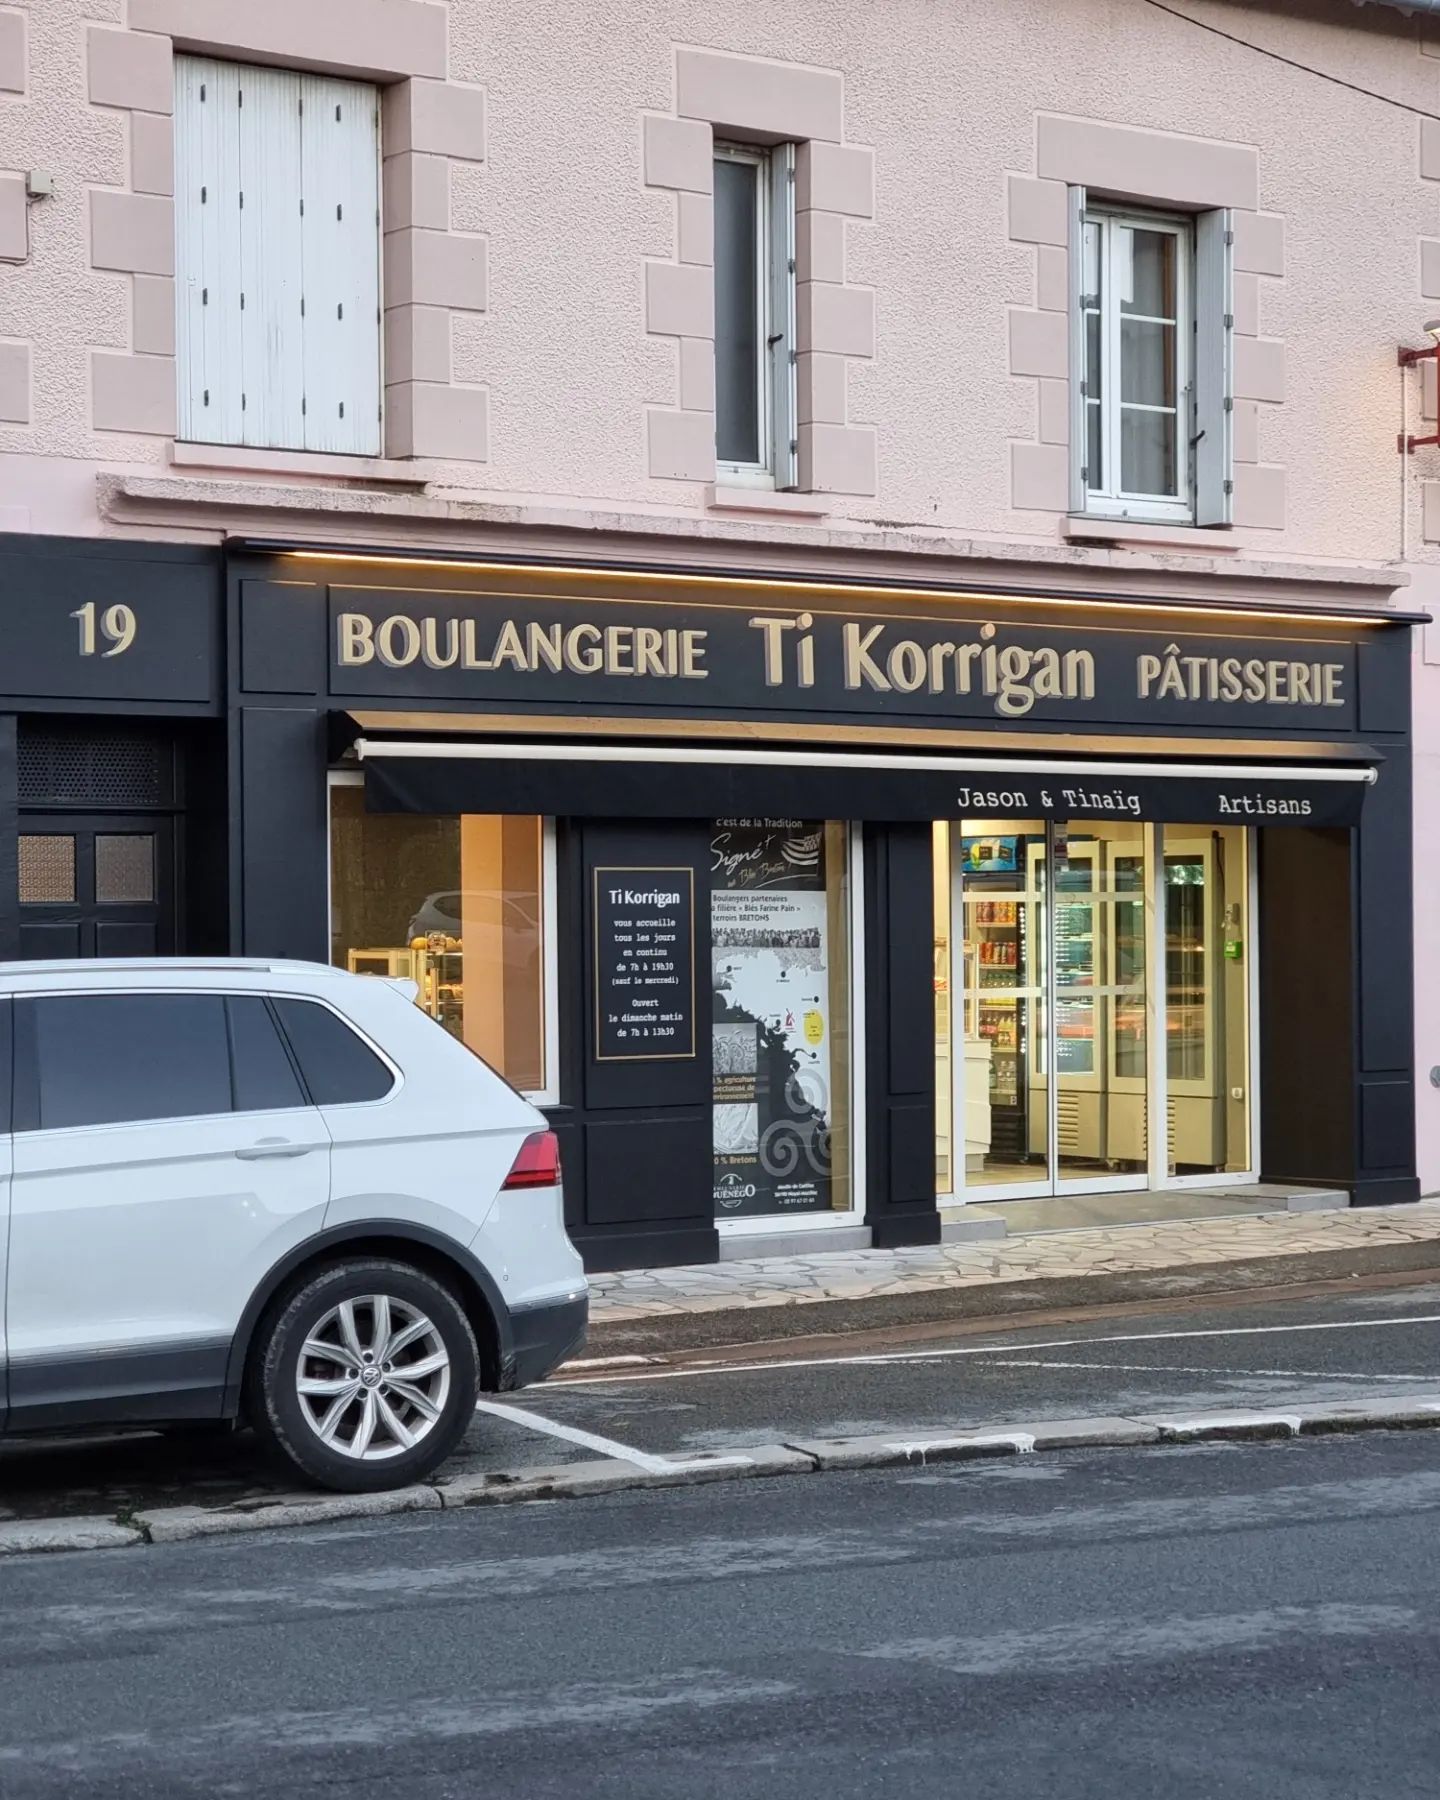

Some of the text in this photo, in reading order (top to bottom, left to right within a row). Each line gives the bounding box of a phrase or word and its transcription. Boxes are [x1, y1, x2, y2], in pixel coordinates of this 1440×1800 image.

[69, 602, 136, 657] 19
[337, 613, 709, 679] BOULANGERIE
[749, 612, 1095, 717] Ti Korrigan
[1137, 643, 1345, 706] PÂTISSERIE
[957, 788, 1140, 815] Jason & Tinaïg
[1218, 794, 1312, 815] Artisans
[764, 817, 803, 829] Tradition
[608, 889, 680, 908] Ti Korrigan
[713, 895, 788, 903] Boulangers partenaires
[636, 918, 676, 927] accueille
[636, 933, 650, 941] les
[654, 932, 676, 943] jours
[636, 947, 667, 956] continu
[616, 962, 674, 971] de 7h à 19h30
[634, 976, 642, 984] le
[645, 976, 679, 985] mercredi)
[632, 999, 659, 1007] Ouvert
[608, 1012, 683, 1022] le dimanche matin
[617, 1027, 675, 1037] de 7h à 13h30
